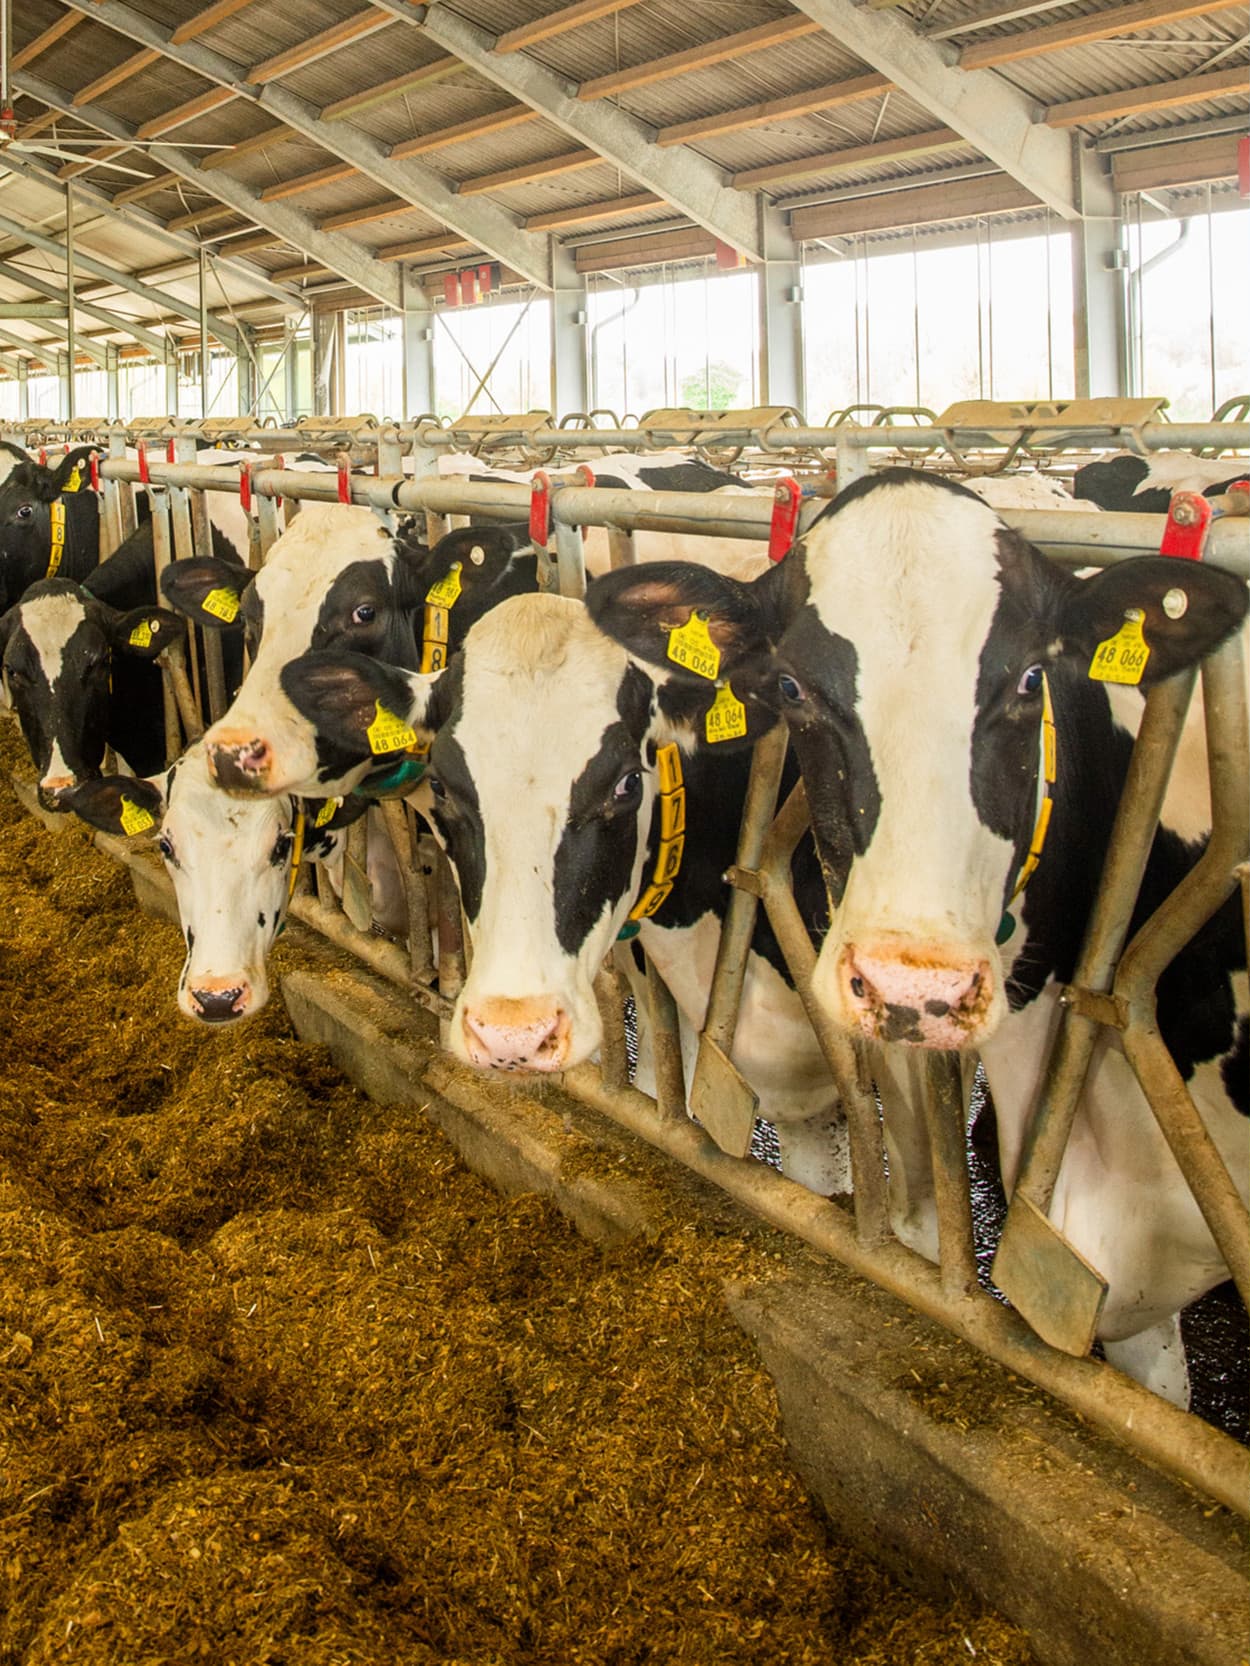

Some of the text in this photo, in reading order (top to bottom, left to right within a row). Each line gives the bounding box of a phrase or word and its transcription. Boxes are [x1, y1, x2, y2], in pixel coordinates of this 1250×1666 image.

[672, 645, 716, 677] 48 066
[1120, 649, 1145, 667] 066
[709, 711, 721, 727] 48
[374, 738, 389, 752] 48
